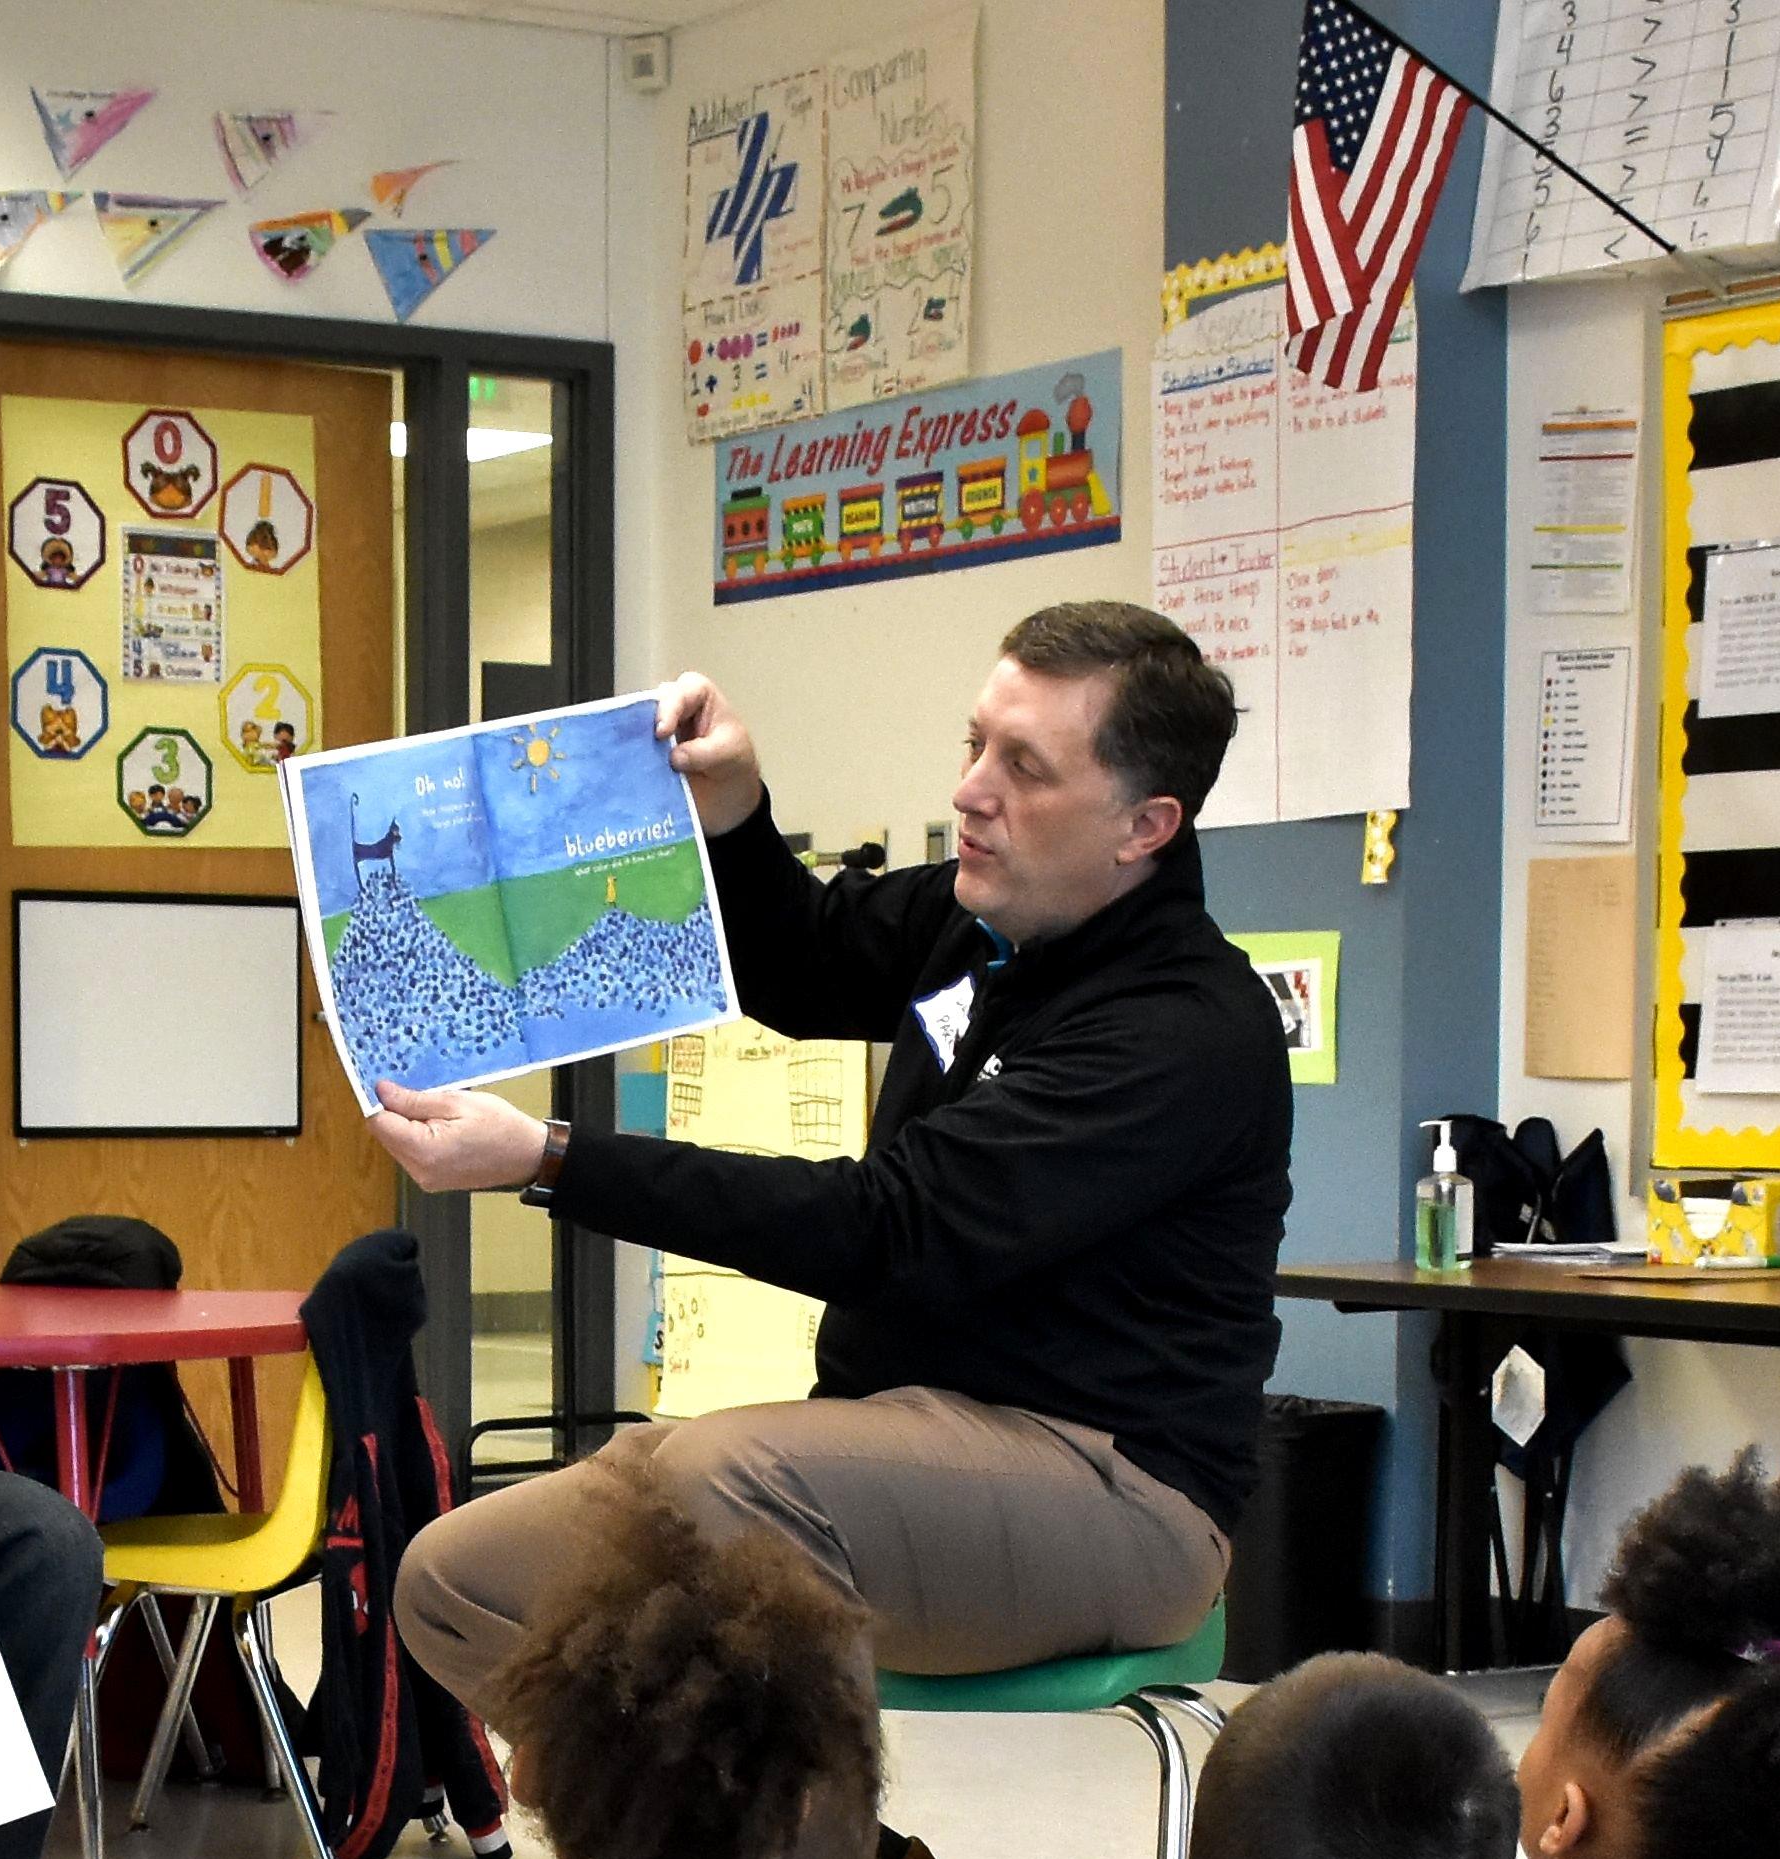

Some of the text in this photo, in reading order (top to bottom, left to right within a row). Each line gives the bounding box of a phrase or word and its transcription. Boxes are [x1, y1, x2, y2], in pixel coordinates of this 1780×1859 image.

[1556, 34, 1574, 65] 4
[1549, 70, 1565, 103] 6
[1545, 107, 1562, 137] 3
[1710, 103, 1736, 140] 5
[1534, 173, 1553, 208] 5
[1706, 137, 1725, 176] 4
[842, 202, 865, 248] 7
[931, 164, 955, 225] 5
[1525, 212, 1541, 244] 6
[153, 420, 183, 465] 0
[726, 445, 764, 481] The
[767, 417, 889, 485] Learning
[894, 397, 1019, 461] Express
[43, 489, 72, 535] 5
[46, 659, 76, 705] 4
[253, 676, 281, 720] 2
[151, 736, 181, 785] 3
[415, 774, 436, 796] Oh
[565, 812, 676, 857] blueberries!
